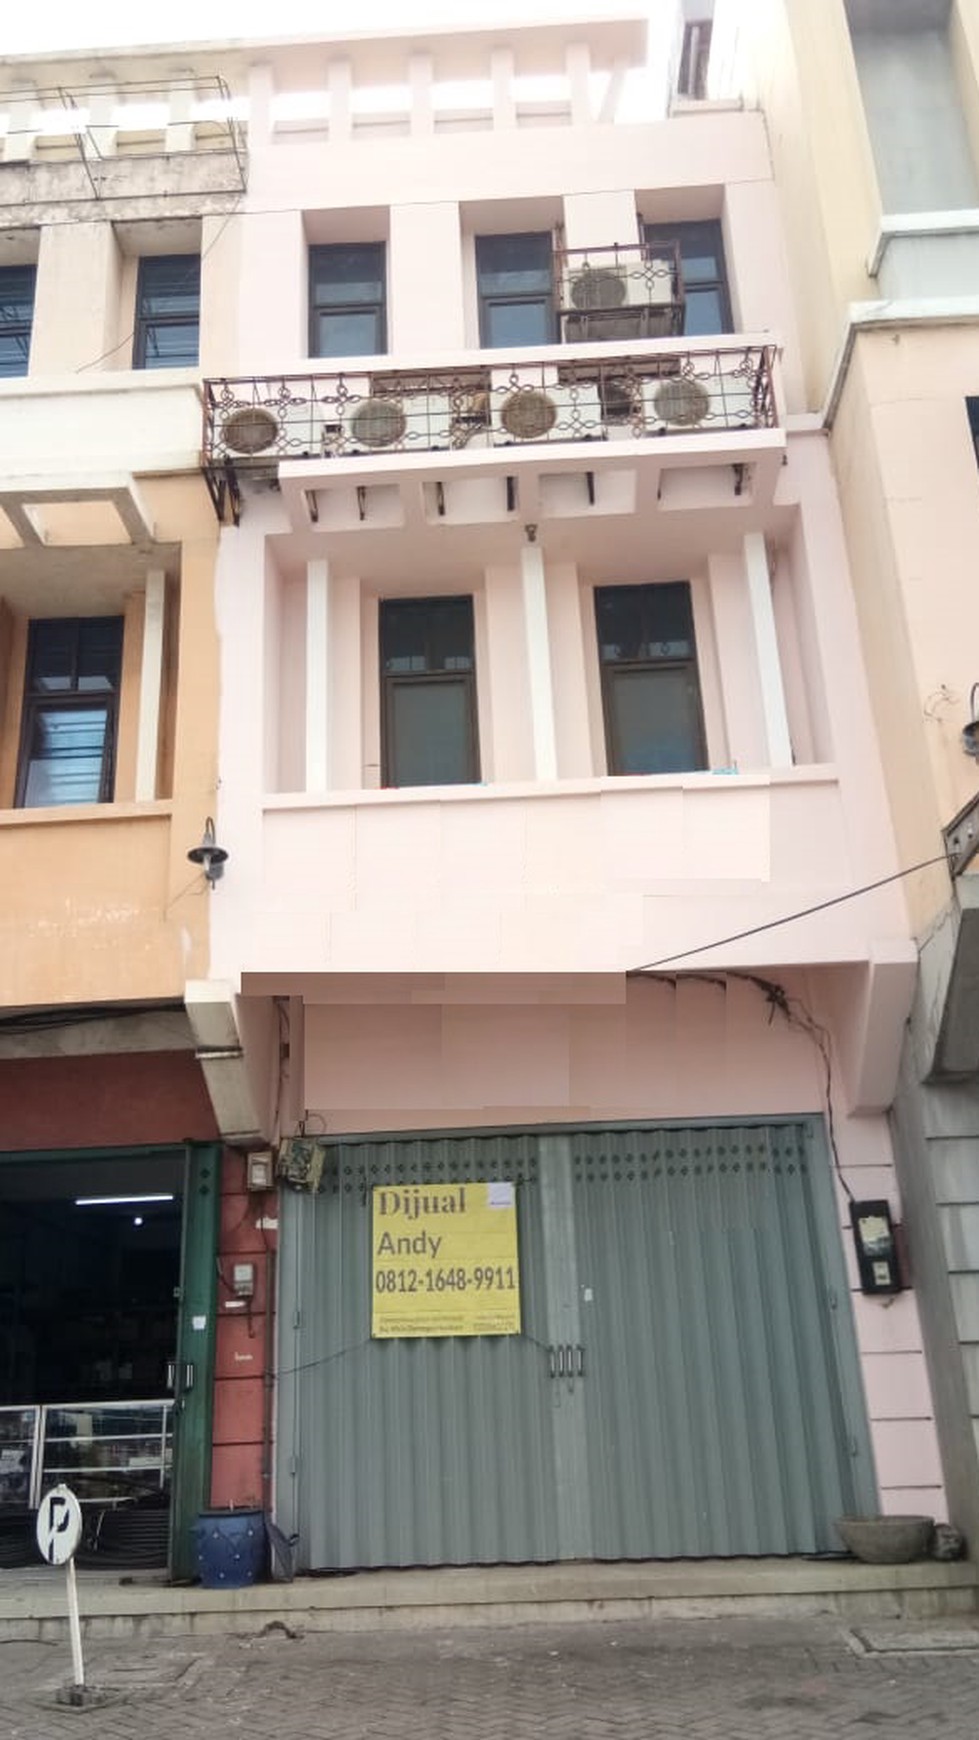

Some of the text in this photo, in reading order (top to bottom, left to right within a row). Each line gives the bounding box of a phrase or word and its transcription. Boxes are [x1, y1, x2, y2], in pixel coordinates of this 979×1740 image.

[379, 1187, 466, 1220] Dijual
[377, 1230, 442, 1259] Andy
[376, 1266, 516, 1293] 0812-1648-9911
